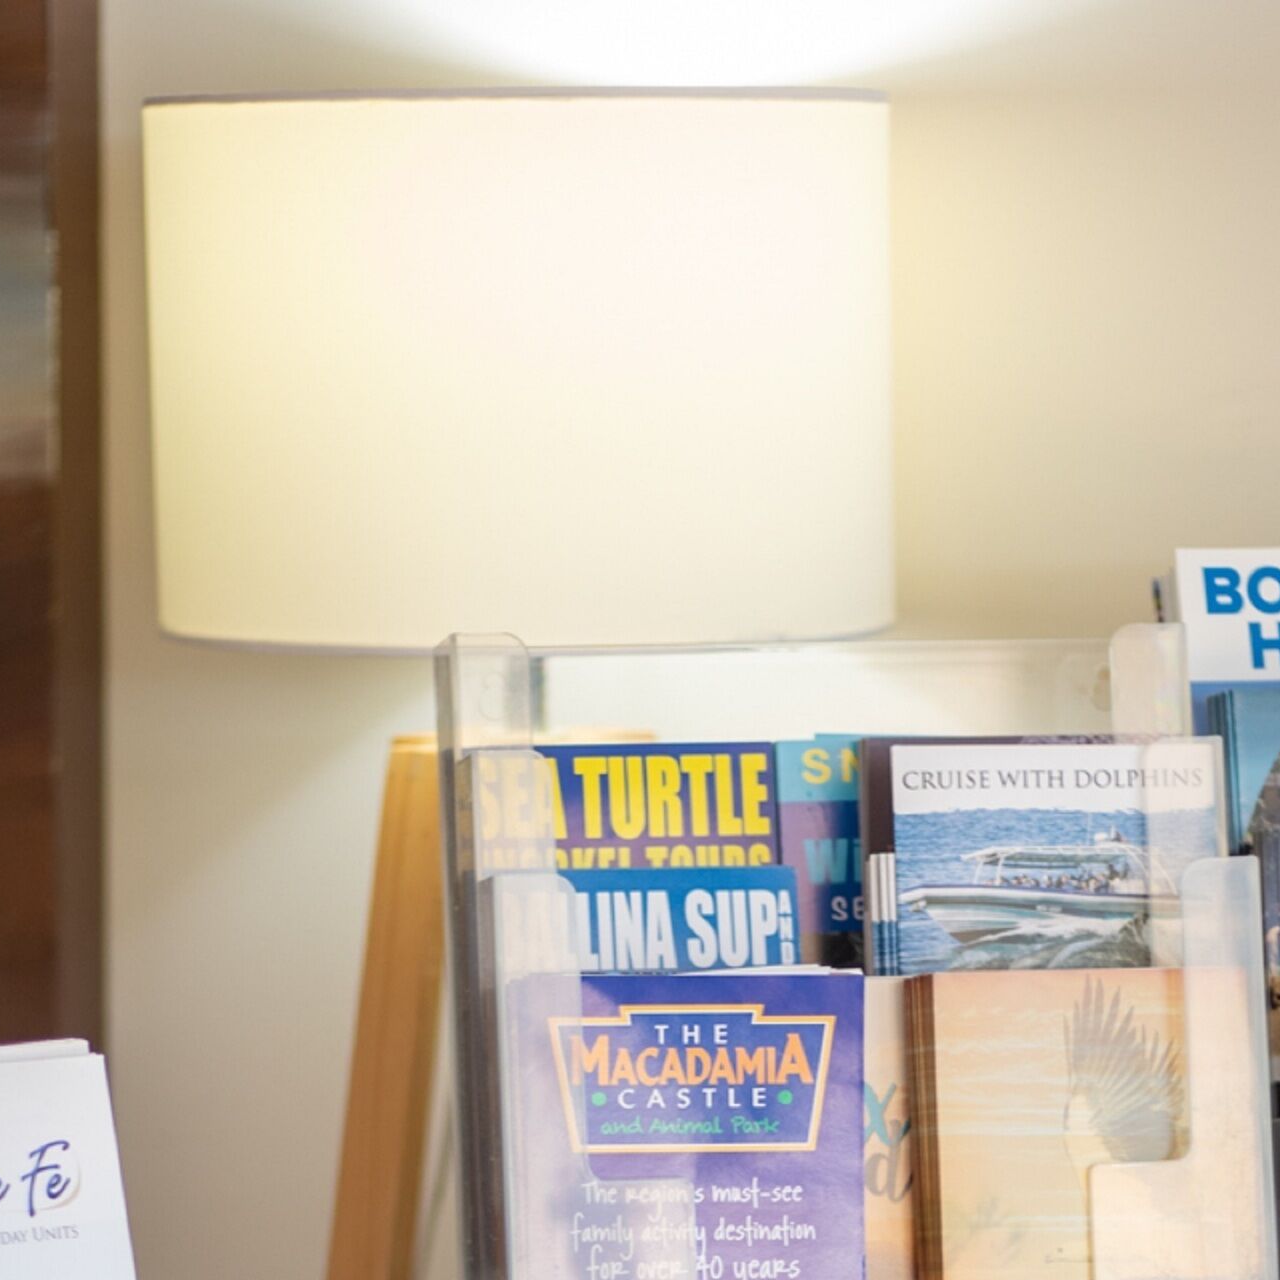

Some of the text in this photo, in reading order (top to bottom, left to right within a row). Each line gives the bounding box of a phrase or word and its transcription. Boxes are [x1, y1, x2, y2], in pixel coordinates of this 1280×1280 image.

[902, 767, 1203, 791] CRUISE WITH DOLPHINS
[478, 755, 569, 840] SEA
[573, 753, 771, 840] TURTLE
[684, 888, 778, 967] SUP
[654, 1023, 729, 1045] THE
[569, 1033, 814, 1087] MACADAMIA
[616, 1087, 769, 1109] CASTLE
[600, 1115, 780, 1135] and Animal Park
[21, 1140, 71, 1218] Fe
[582, 1181, 618, 1205] The
[712, 1176, 803, 1209] must-see
[32, 1225, 80, 1241] UNITS
[570, 1212, 634, 1260] family
[714, 1216, 817, 1247] destination
